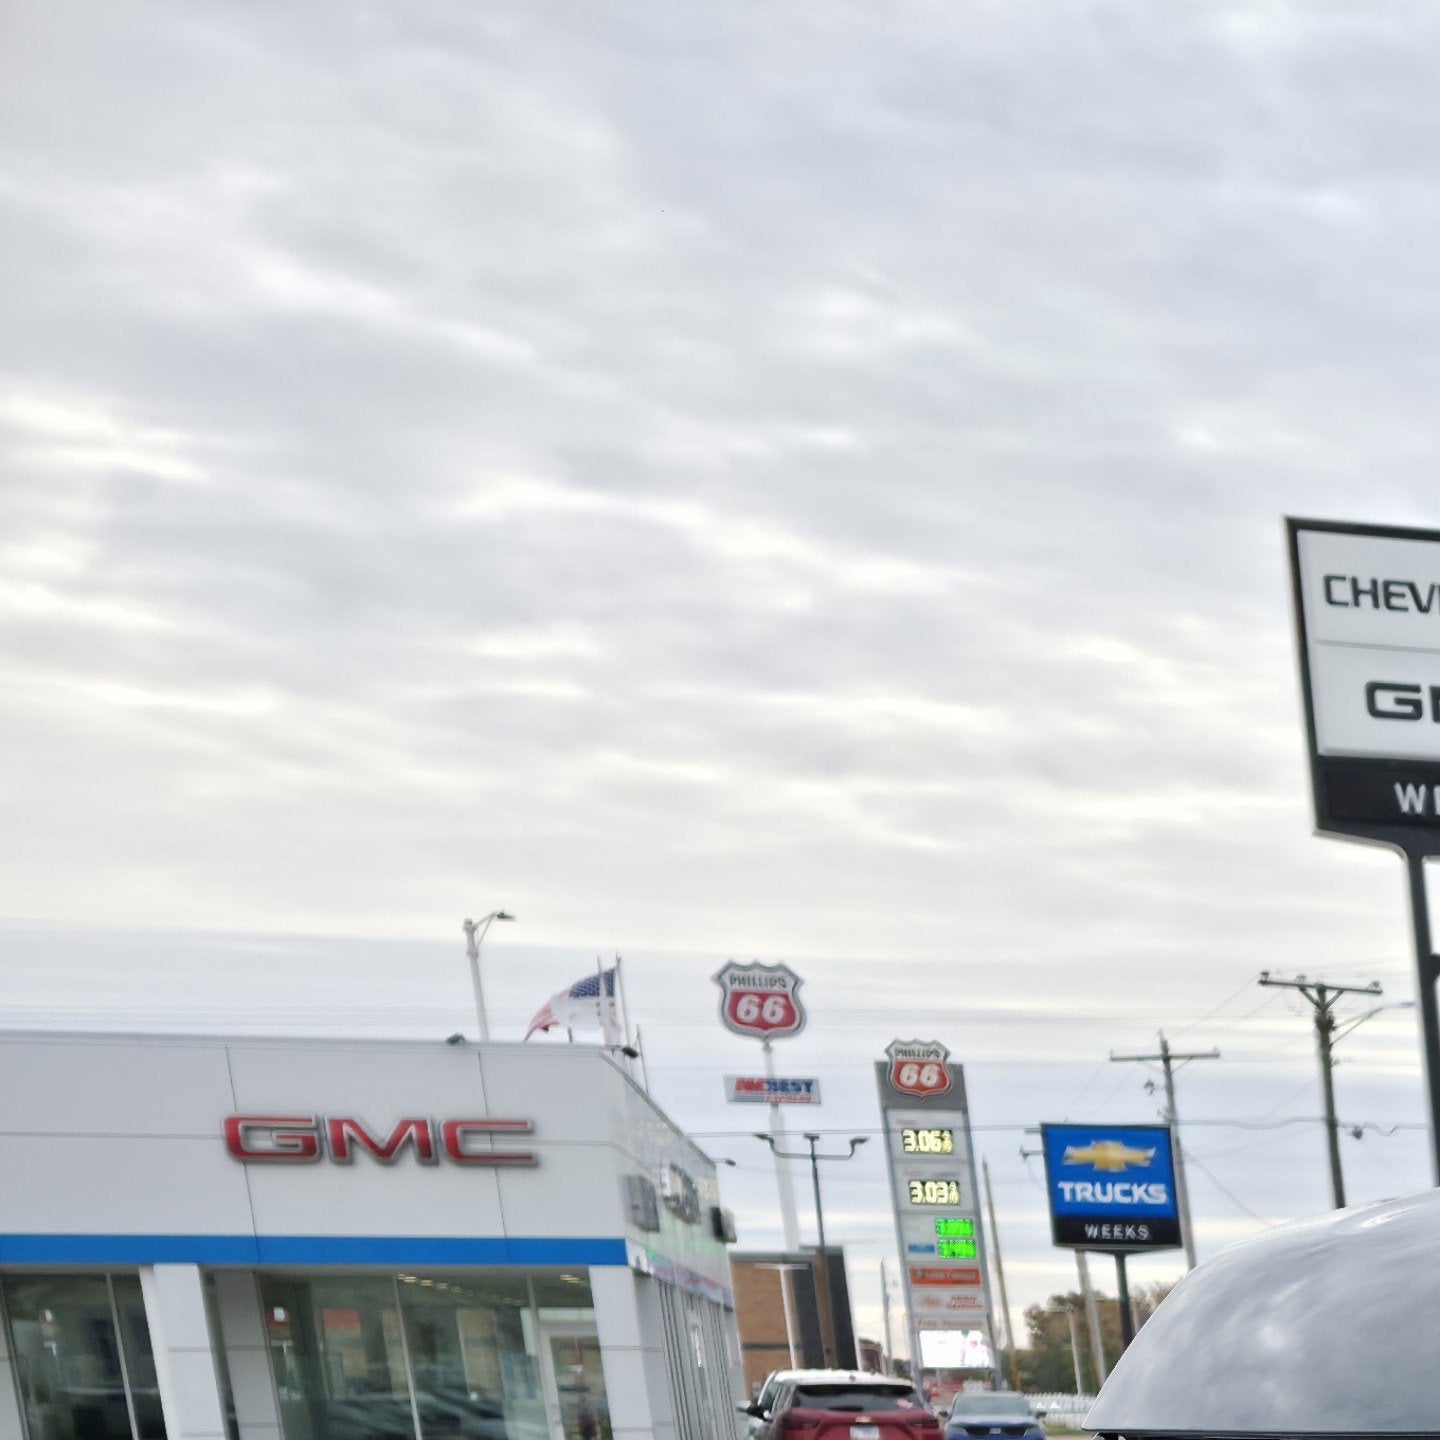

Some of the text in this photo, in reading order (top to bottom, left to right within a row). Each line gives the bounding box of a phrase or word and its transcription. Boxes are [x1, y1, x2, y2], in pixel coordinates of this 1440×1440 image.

[729, 973, 788, 989] PHILLIPS
[736, 993, 786, 1025] 66
[899, 1063, 941, 1087] 66
[222, 1114, 538, 1166] GMC
[1057, 1180, 1168, 1205] TRUCKS
[1084, 1223, 1150, 1241] WEEKS
